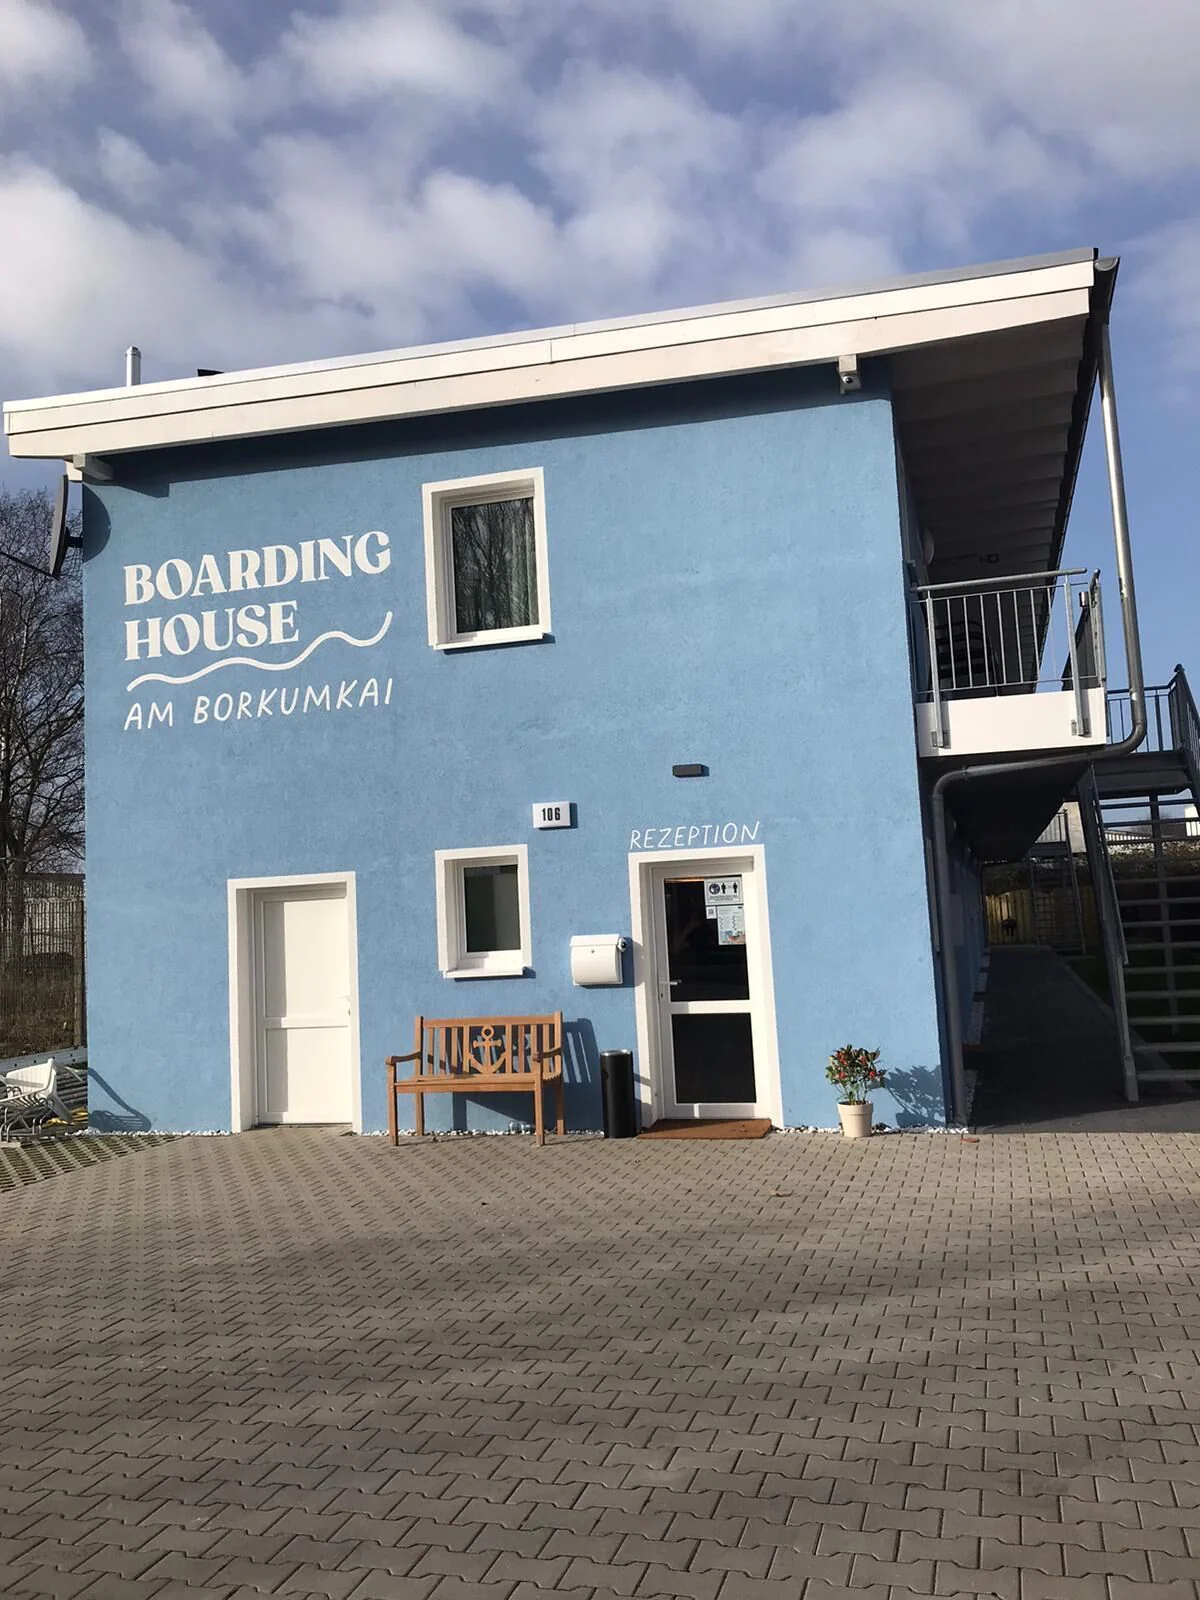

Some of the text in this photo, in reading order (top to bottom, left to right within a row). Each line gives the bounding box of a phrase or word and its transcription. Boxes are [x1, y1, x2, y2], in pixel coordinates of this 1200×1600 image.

[123, 530, 391, 606] BOARDING
[124, 600, 299, 661] HOUSE
[123, 678, 393, 731] AM BORKUMKAI
[541, 807, 561, 822] 106
[629, 821, 760, 849] REZEPTION
